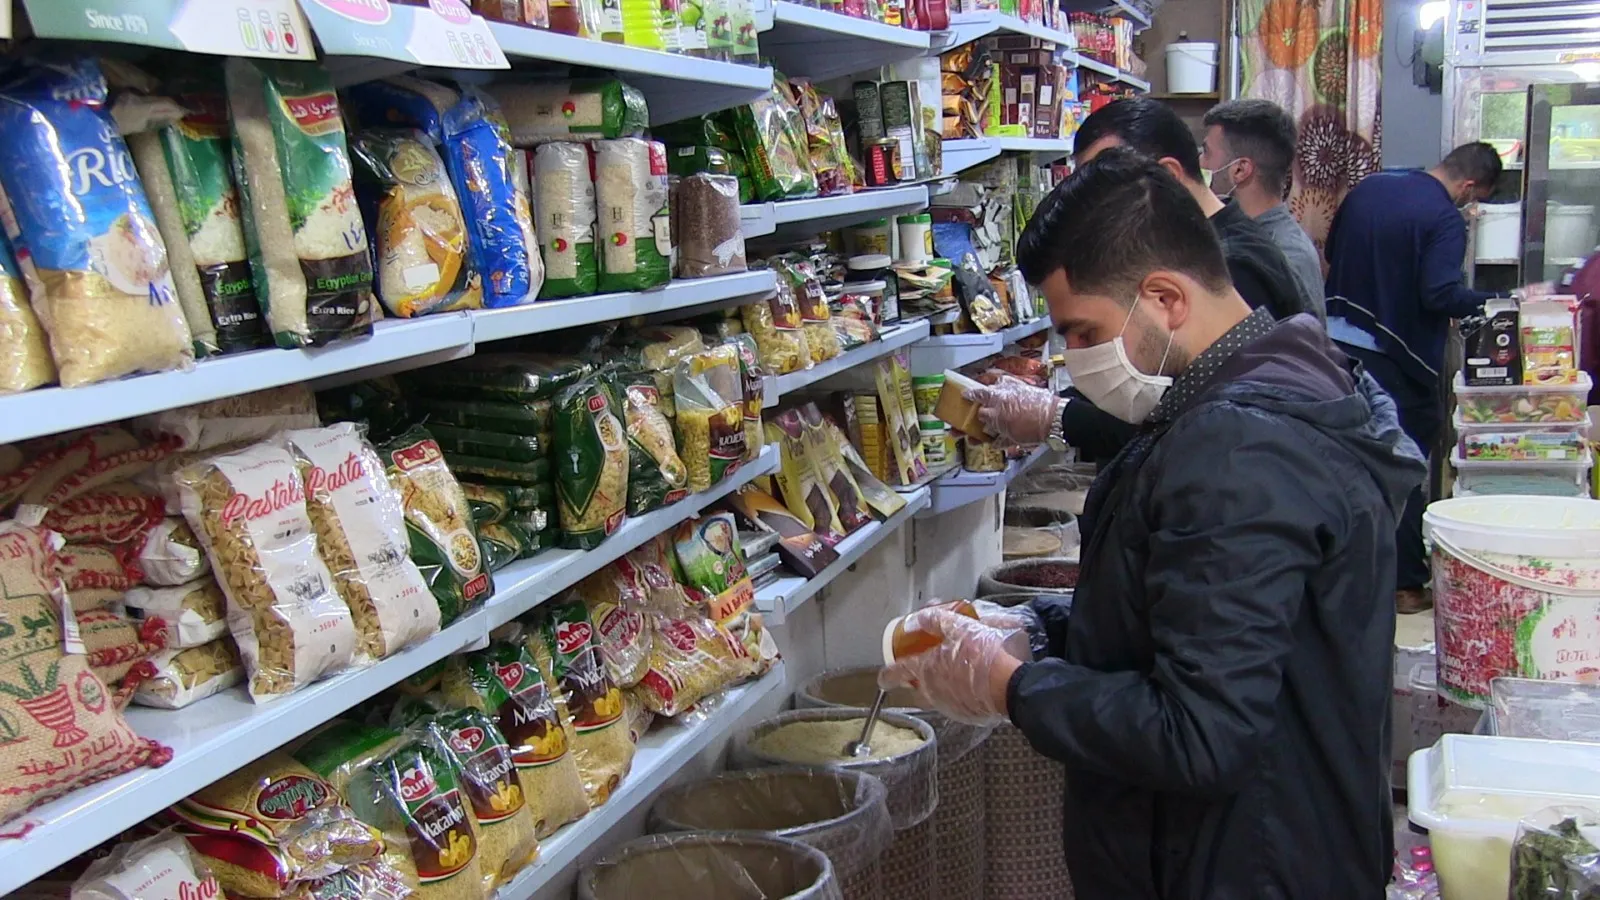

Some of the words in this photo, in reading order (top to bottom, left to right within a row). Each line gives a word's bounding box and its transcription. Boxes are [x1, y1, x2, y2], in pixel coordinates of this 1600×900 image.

[436, 1, 468, 18] Durra
[85, 8, 123, 31] Since
[312, 306, 335, 315] Extra
[337, 306, 355, 315] Rice
[218, 314, 243, 326] Extra
